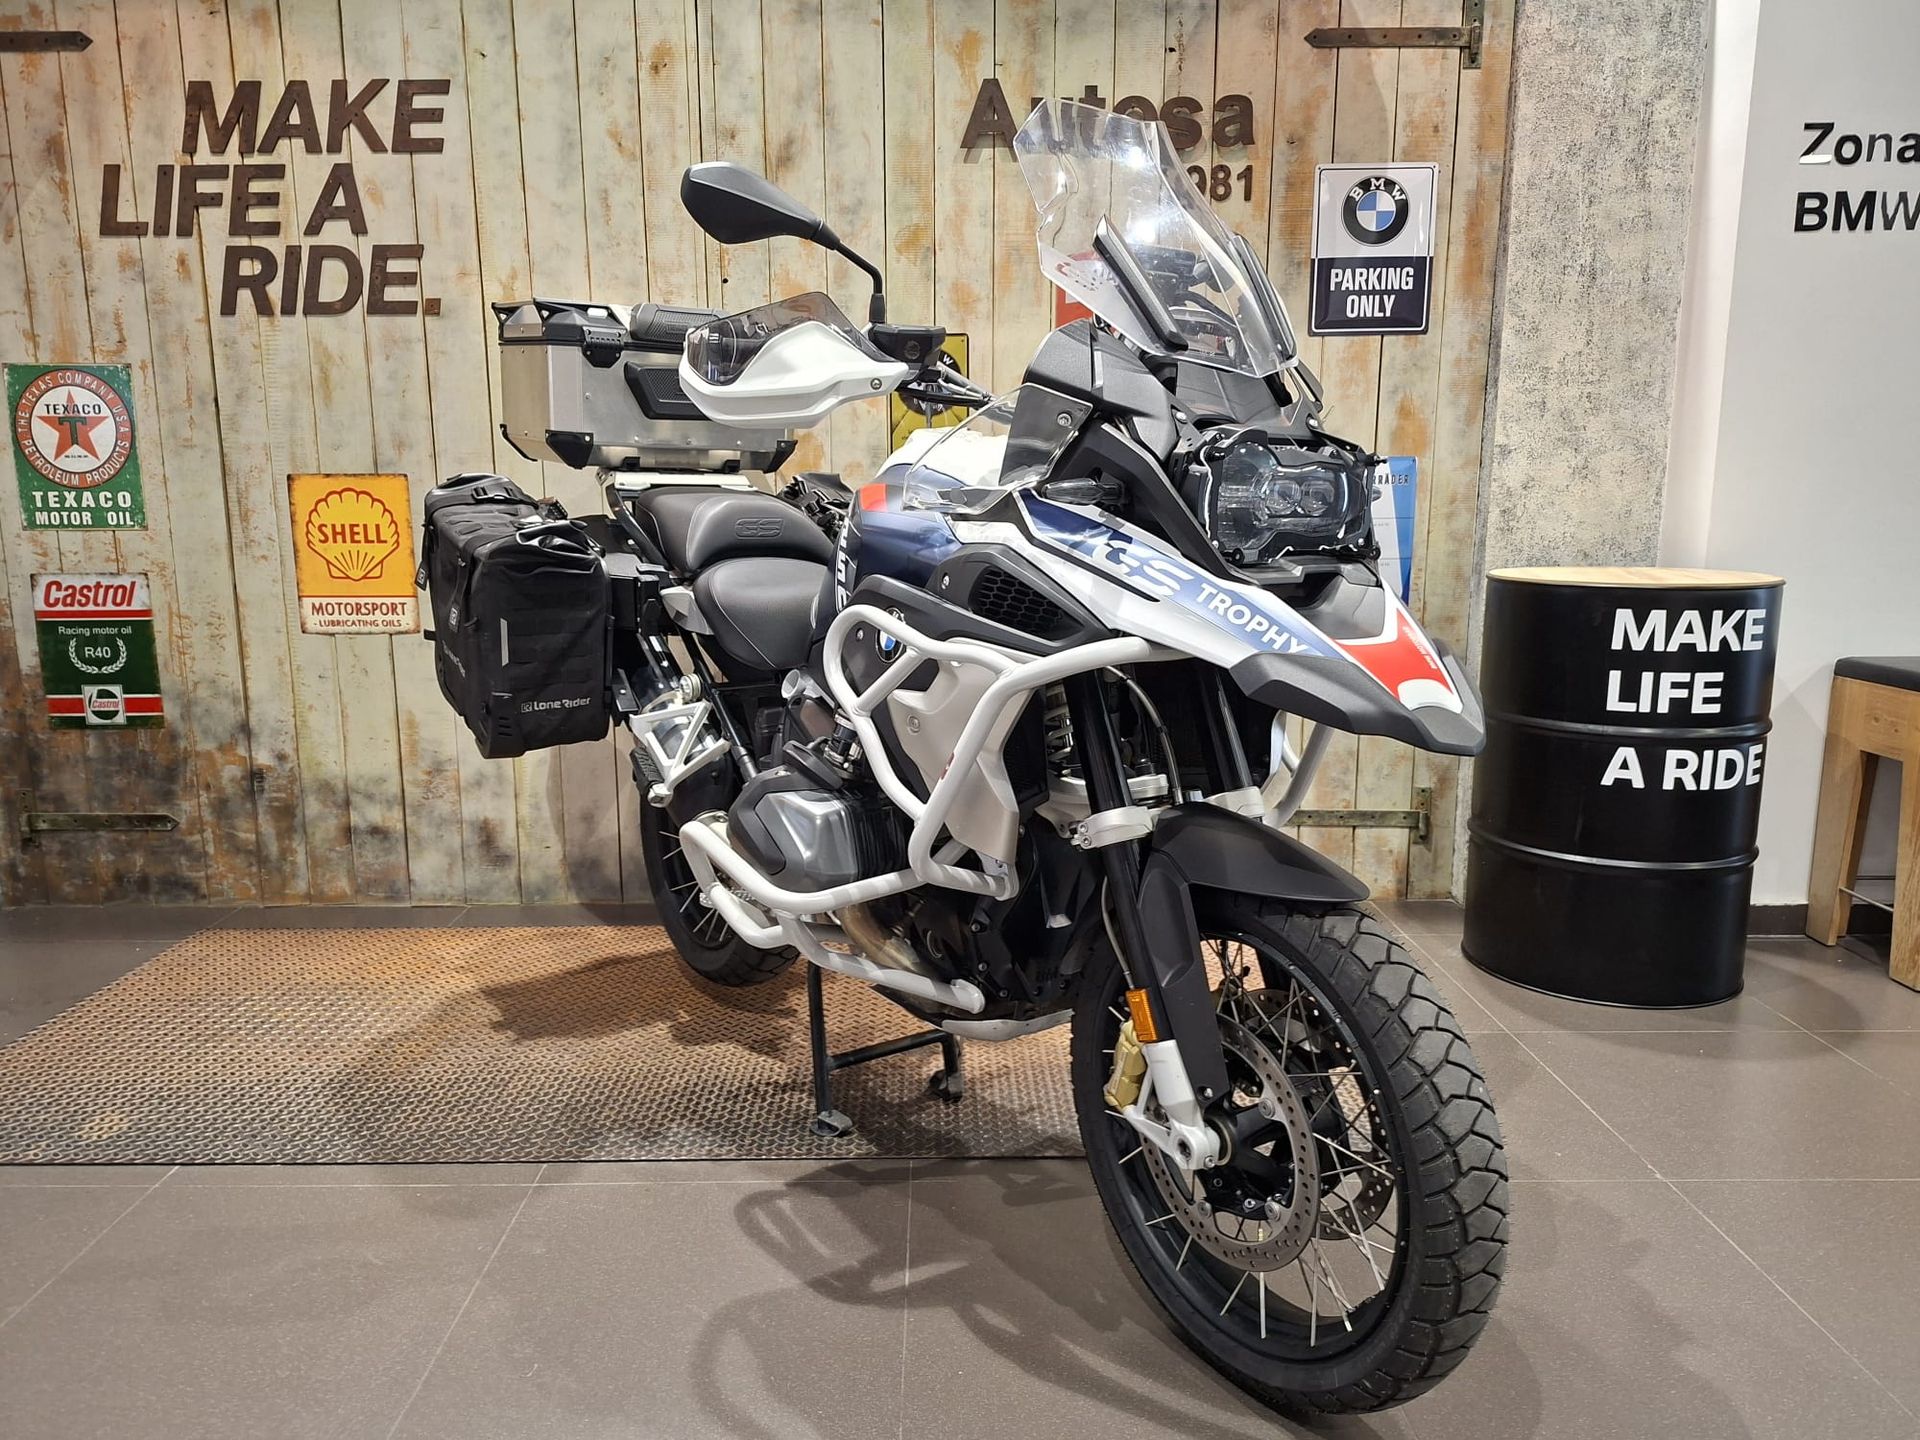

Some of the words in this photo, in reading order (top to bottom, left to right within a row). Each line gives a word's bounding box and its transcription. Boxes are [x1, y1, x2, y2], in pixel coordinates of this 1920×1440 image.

[181, 78, 451, 154] MAKE
[1799, 121, 1920, 165] Zona
[100, 163, 286, 237] LIFE
[303, 162, 368, 236] A
[1350, 177, 1406, 202] BMW
[1794, 190, 1920, 232] BMW
[219, 244, 442, 317] RIDE.
[1330, 267, 1414, 291] PARKING
[1346, 294, 1396, 318] ONLY
[18, 410, 30, 433] THE
[24, 376, 53, 406] TEXAS
[57, 372, 115, 401] COMPANY
[44, 403, 102, 415] TEXACO
[21, 439, 80, 486] PETROLEUM
[85, 440, 130, 485] PRODUCTS
[32, 491, 132, 508] TEXACO
[35, 511, 93, 525] MOTOR
[107, 511, 134, 525] OIL
[317, 523, 388, 545] SHELL
[43, 580, 136, 608] Castrol
[311, 602, 407, 617] MOTORSPORT
[1195, 582, 1309, 655] TROPHY
[58, 626, 91, 637] Racing
[92, 626, 119, 635] motor
[121, 626, 132, 634] oil
[319, 619, 379, 627] LUBRICATING
[382, 619, 402, 627] OILS
[1611, 608, 1767, 652] MAKE
[84, 646, 111, 659] R40
[92, 699, 120, 709] Castrol
[1606, 670, 1724, 714] LIFE
[1600, 746, 1645, 789] A
[1662, 743, 1763, 791] RIDE
